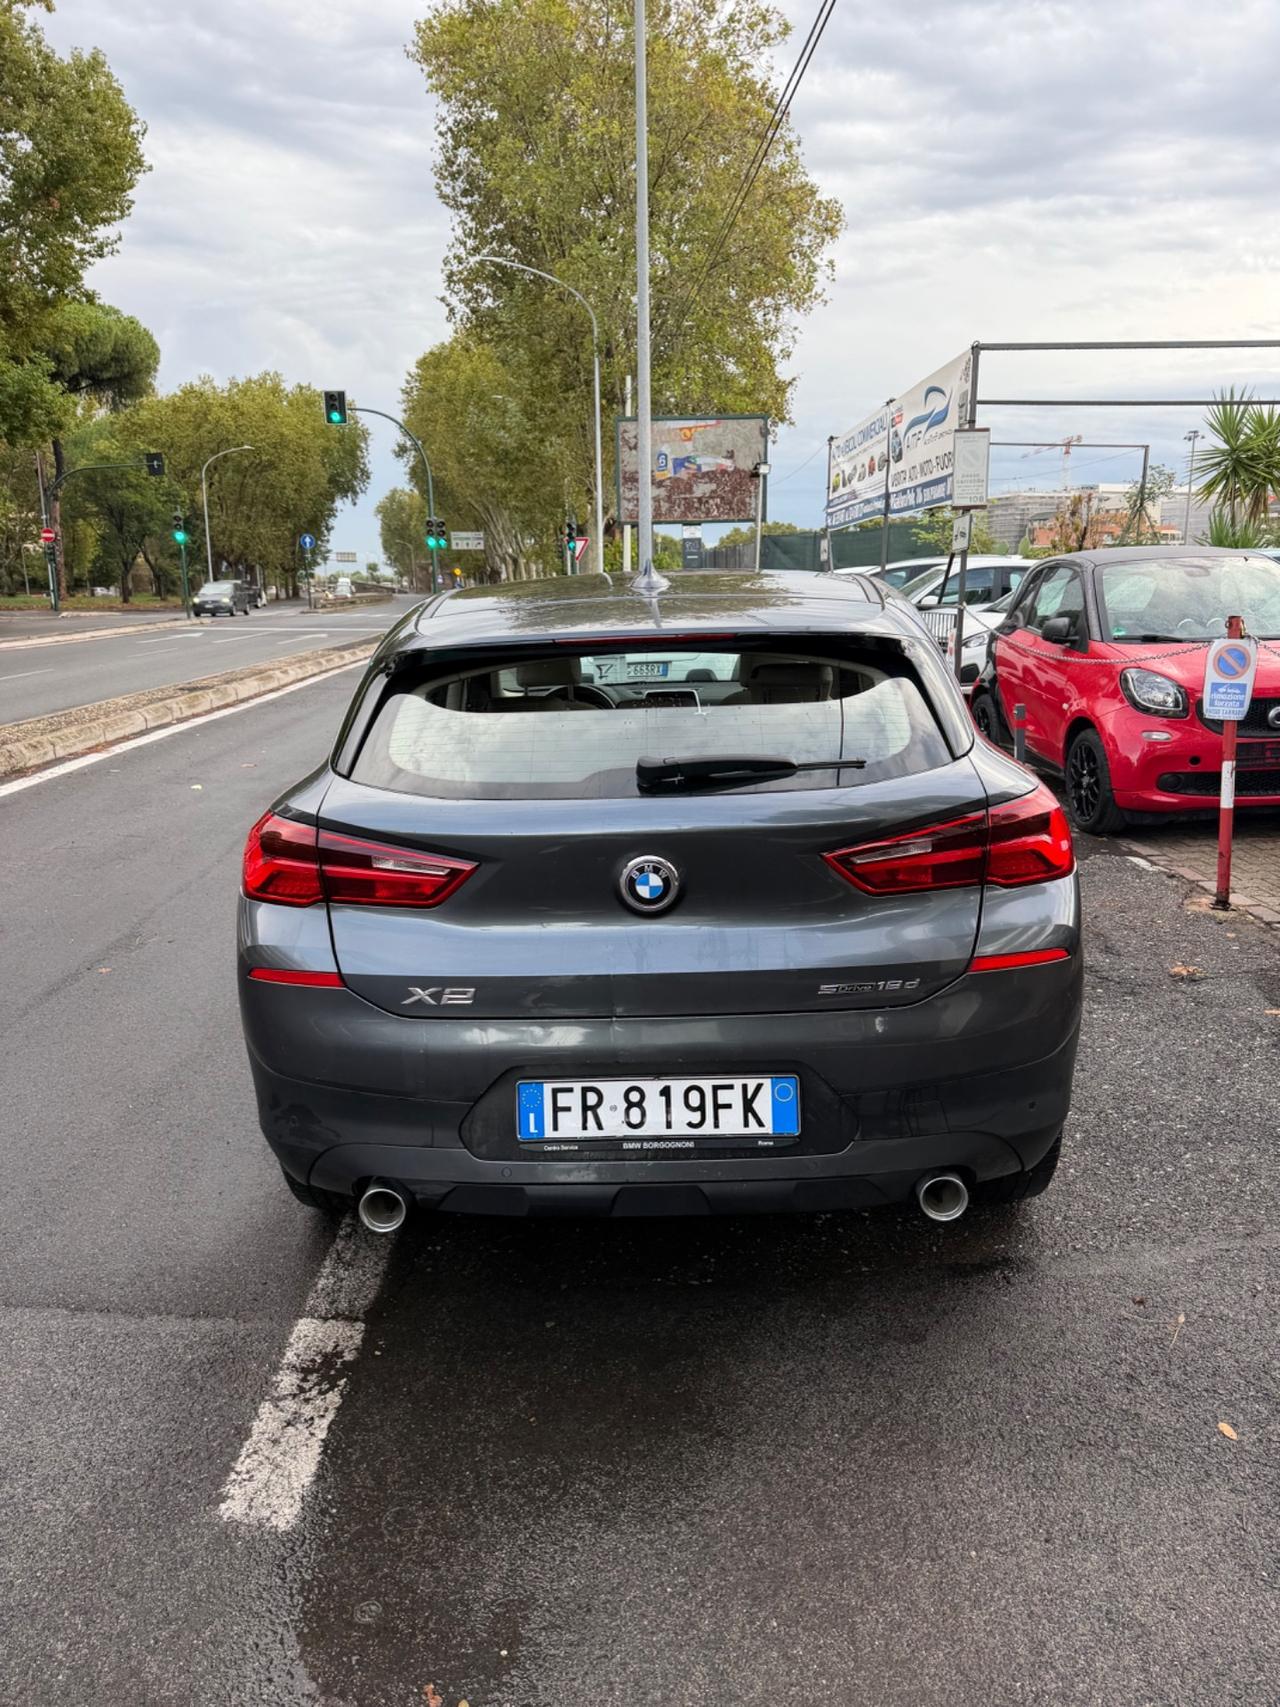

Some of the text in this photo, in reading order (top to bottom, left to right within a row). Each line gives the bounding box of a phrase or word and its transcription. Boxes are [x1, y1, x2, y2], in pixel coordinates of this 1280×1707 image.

[631, 865, 668, 879] BMW
[400, 986, 476, 1006] X2
[622, 1142, 641, 1150] BMW
[642, 1141, 695, 1149] BORGOGNONI
